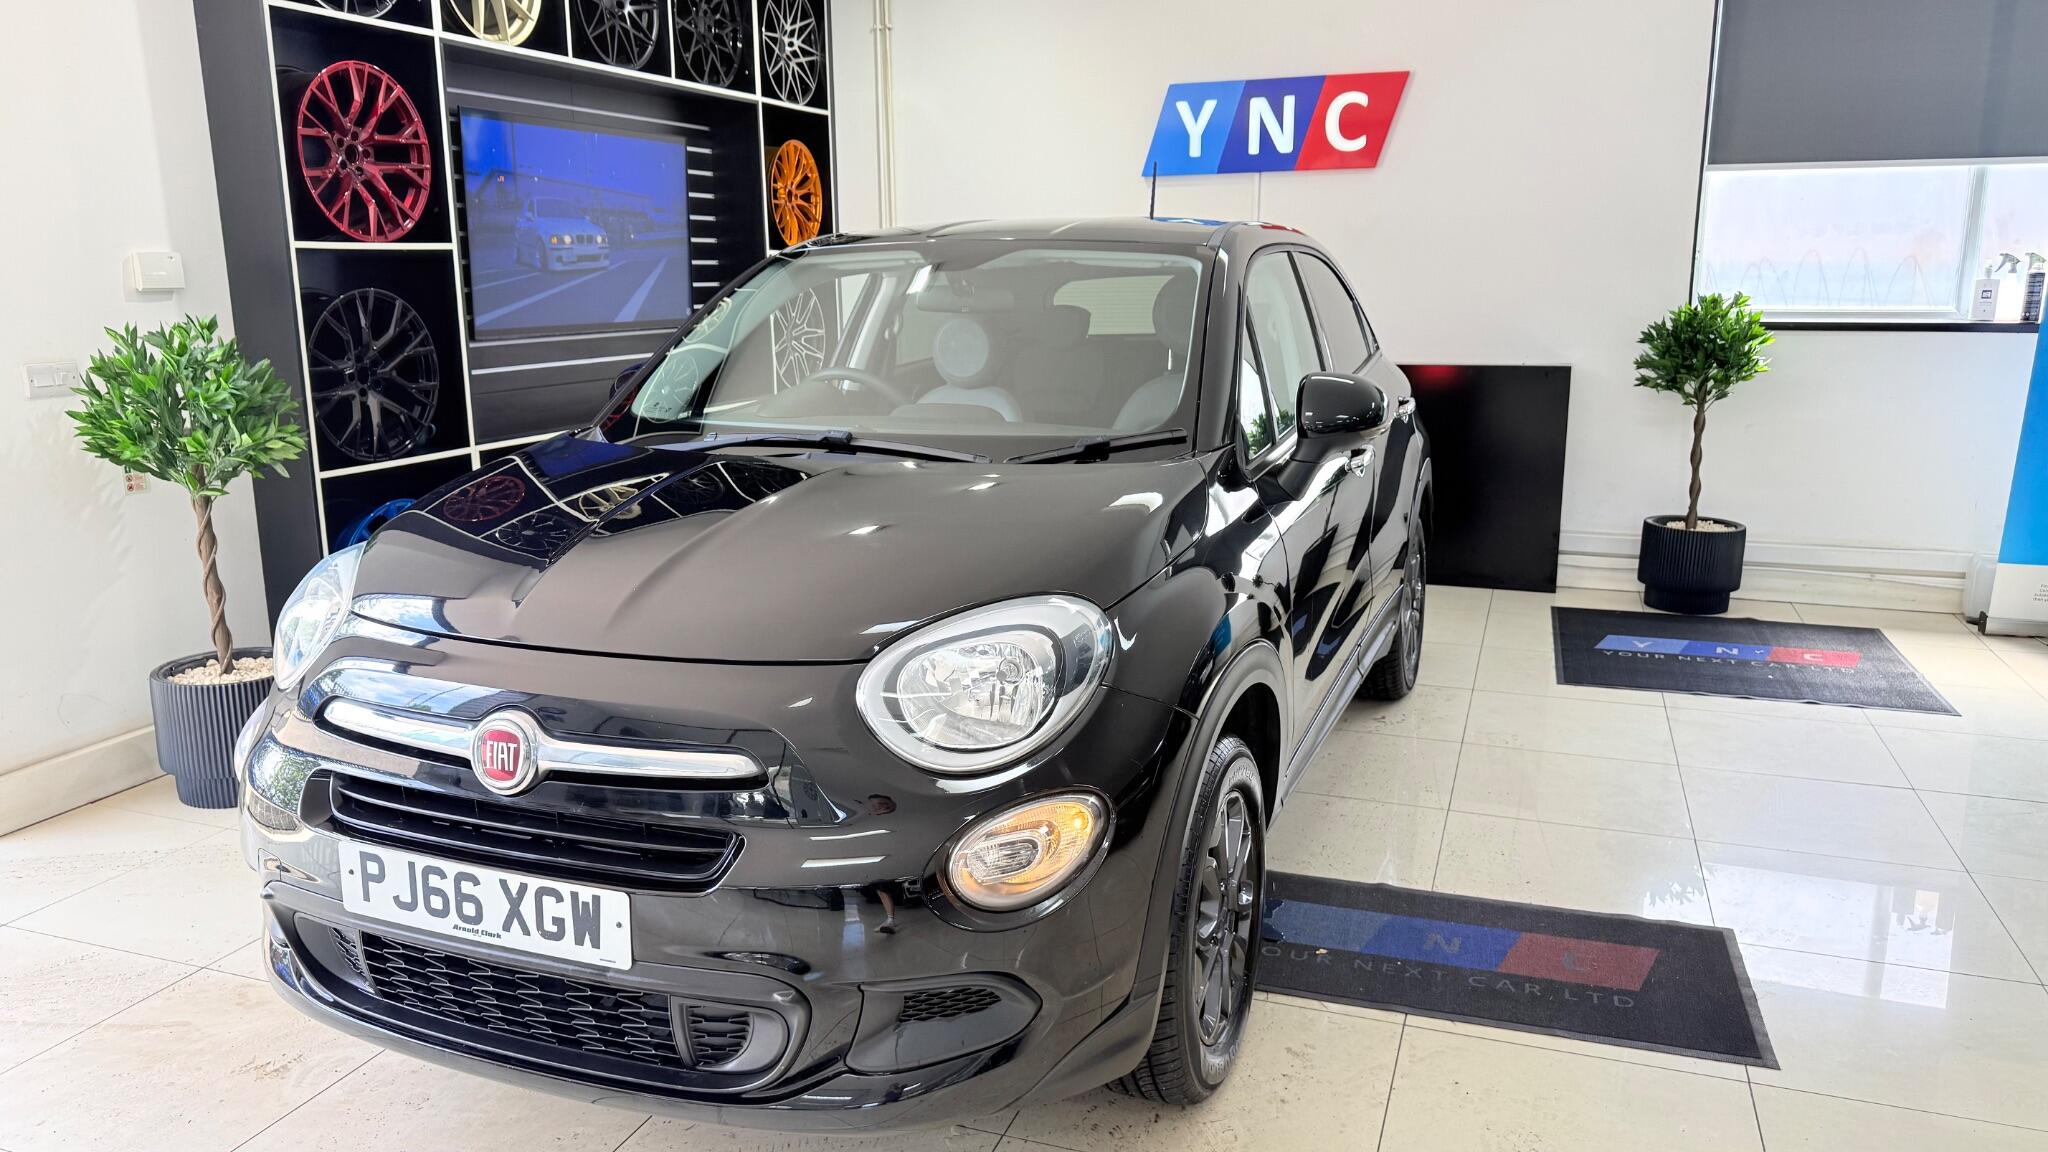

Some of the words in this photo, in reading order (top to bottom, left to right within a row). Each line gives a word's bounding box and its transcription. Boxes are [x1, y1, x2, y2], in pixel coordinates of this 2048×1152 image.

[1174, 90, 1370, 158] YNC
[1603, 650, 1665, 659] YOUR
[1678, 655, 1736, 664] NEXT
[485, 740, 518, 772] FIAT
[359, 850, 484, 926] PJ66
[499, 878, 601, 950] XGW
[452, 924, 480, 935] Arnold
[480, 929, 502, 939] Clark
[1261, 945, 1332, 966] OUR
[1353, 958, 1448, 981] NEXT
[1468, 976, 1542, 996] CAR
[1564, 987, 1634, 1008] LTD
